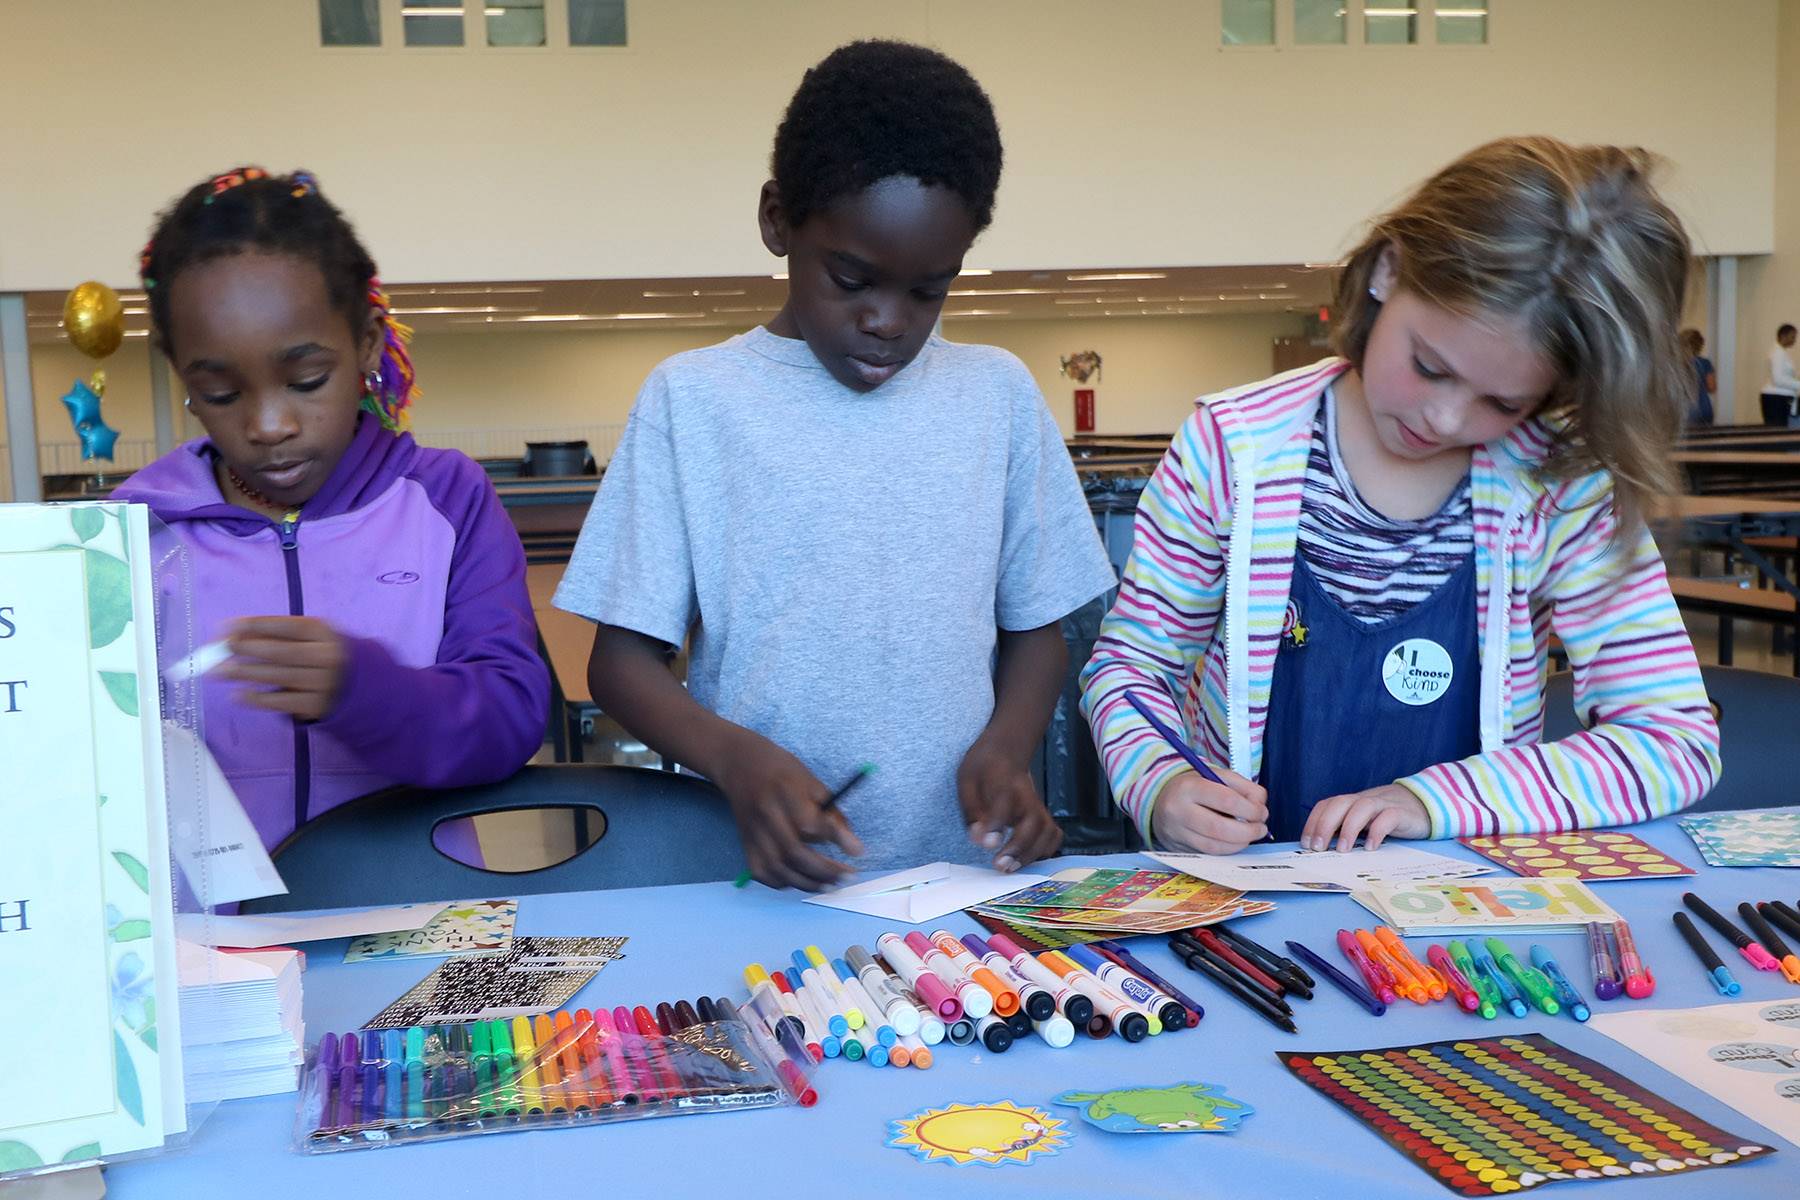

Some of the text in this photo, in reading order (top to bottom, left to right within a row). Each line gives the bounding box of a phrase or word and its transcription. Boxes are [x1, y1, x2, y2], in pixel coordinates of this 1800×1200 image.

[1408, 668, 1450, 679] choose
[0, 680, 28, 713] T
[410, 929, 461, 938] YOU
[389, 936, 478, 947] THANK
